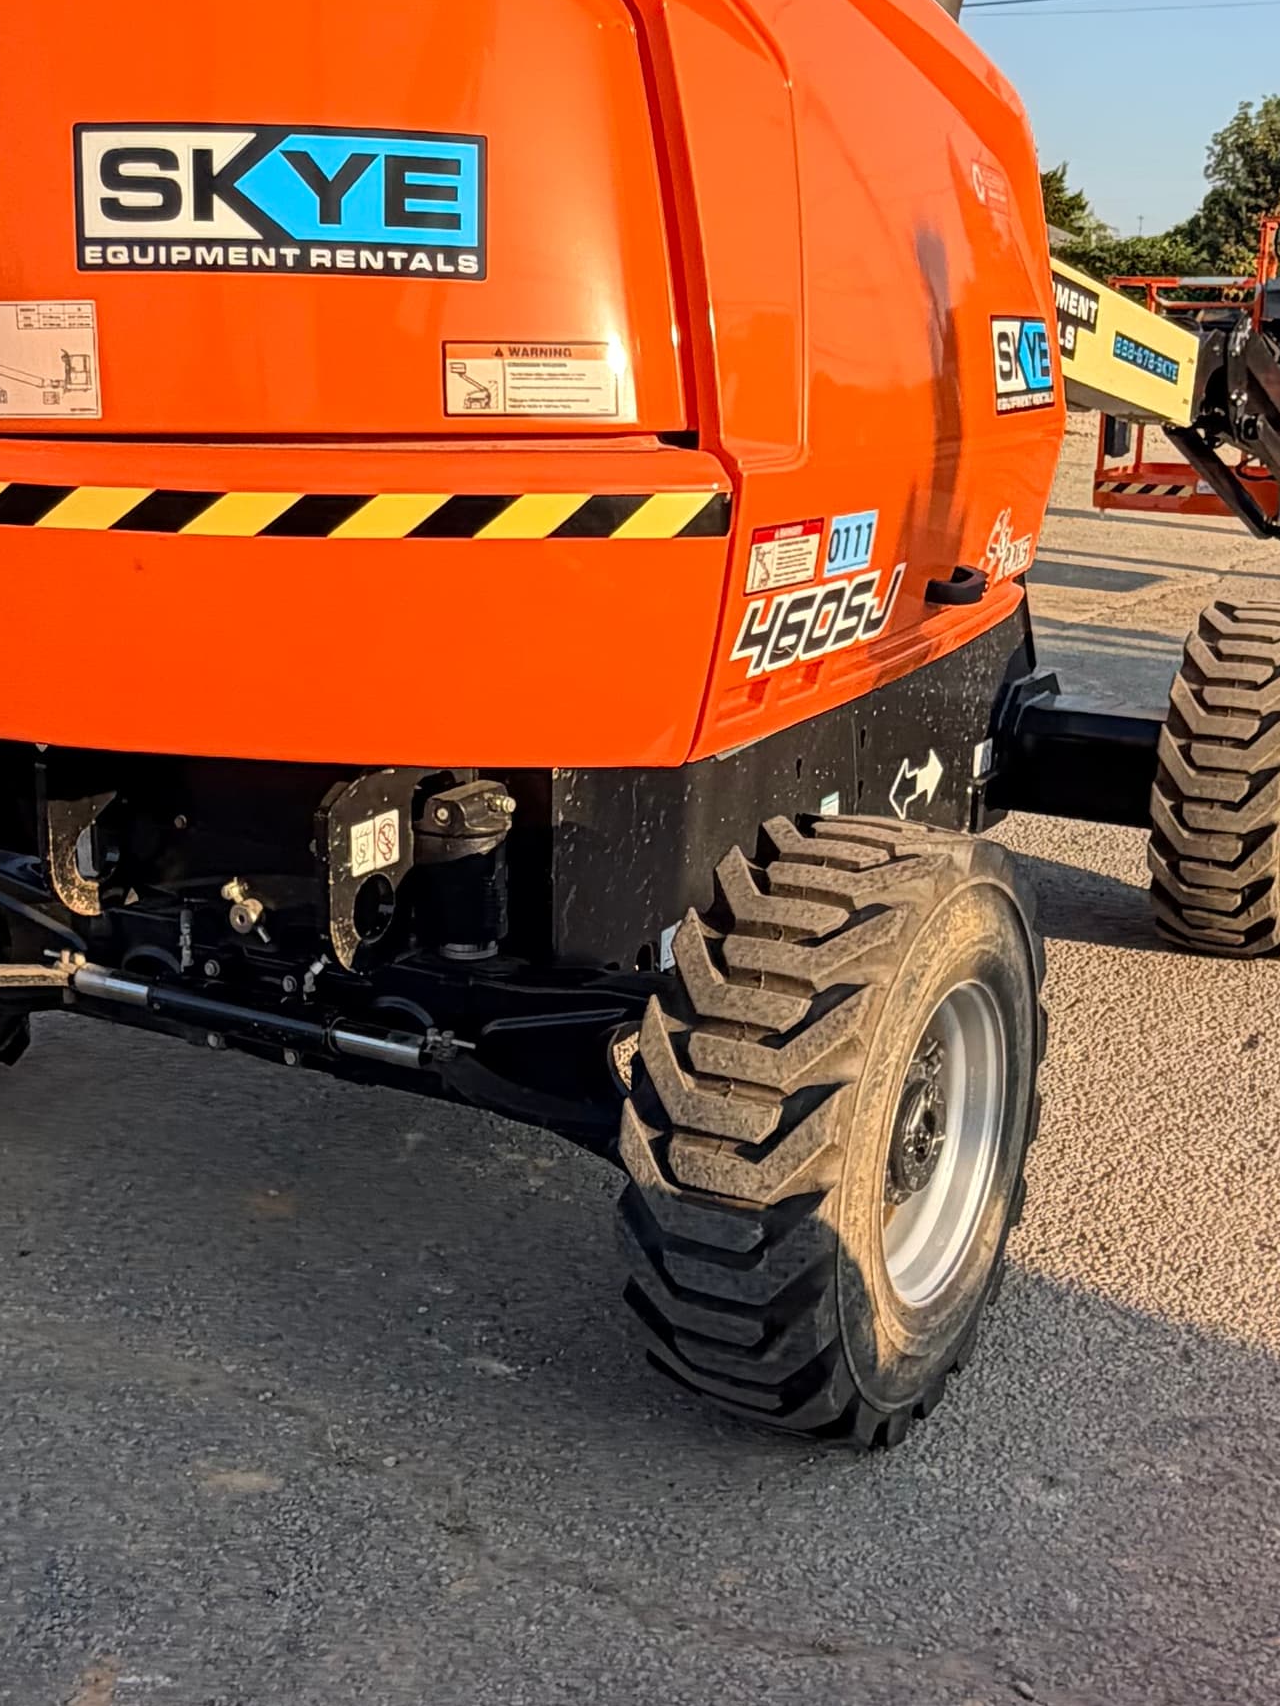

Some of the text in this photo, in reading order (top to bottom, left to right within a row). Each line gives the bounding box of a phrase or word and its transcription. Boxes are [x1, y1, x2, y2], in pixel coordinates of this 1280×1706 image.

[99, 141, 463, 233] SKYE
[84, 246, 479, 275] EQUIPMENT RENTALS
[1052, 281, 1098, 325] MENT
[508, 347, 572, 358] WARNING
[997, 331, 1051, 382] SKYE
[828, 522, 874, 564] 0111
[730, 562, 907, 679] 460SJ
